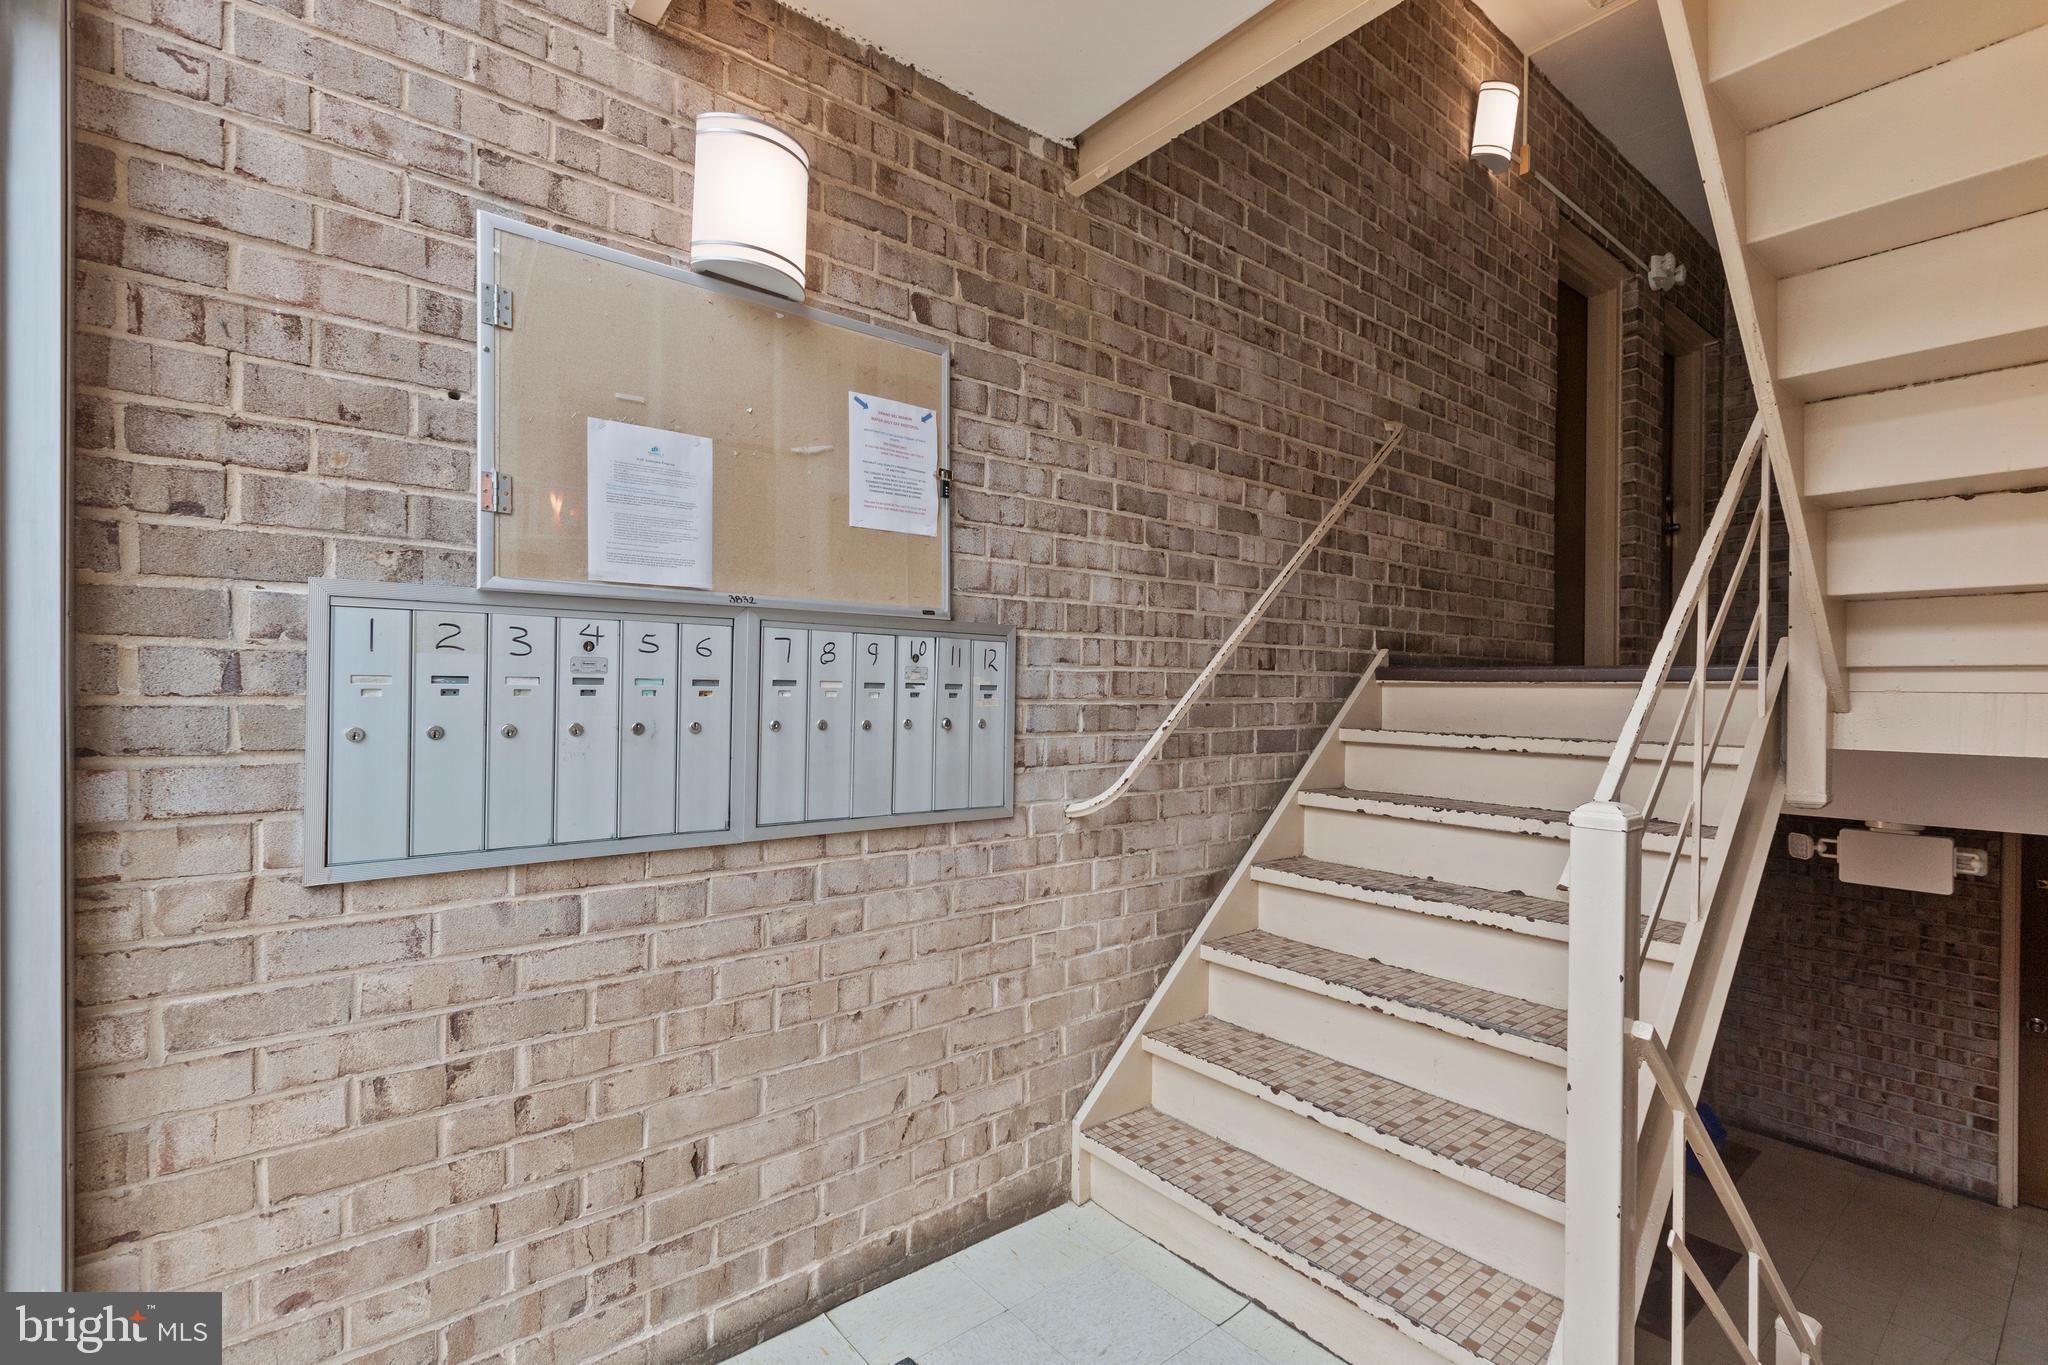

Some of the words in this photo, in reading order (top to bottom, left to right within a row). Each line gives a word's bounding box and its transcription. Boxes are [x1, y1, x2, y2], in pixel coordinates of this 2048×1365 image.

[728, 594, 757, 604] 3832
[370, 617, 374, 652] 1
[435, 622, 466, 651] 2
[508, 626, 533, 656] 3
[579, 623, 605, 647] 4
[638, 633, 660, 654] 5
[695, 637, 713, 658] 6
[774, 637, 792, 664] 7
[820, 641, 836, 665] 8
[867, 642, 879, 667] 9
[910, 640, 927, 660] 10
[951, 645, 962, 668] 11
[983, 648, 999, 672] 12
